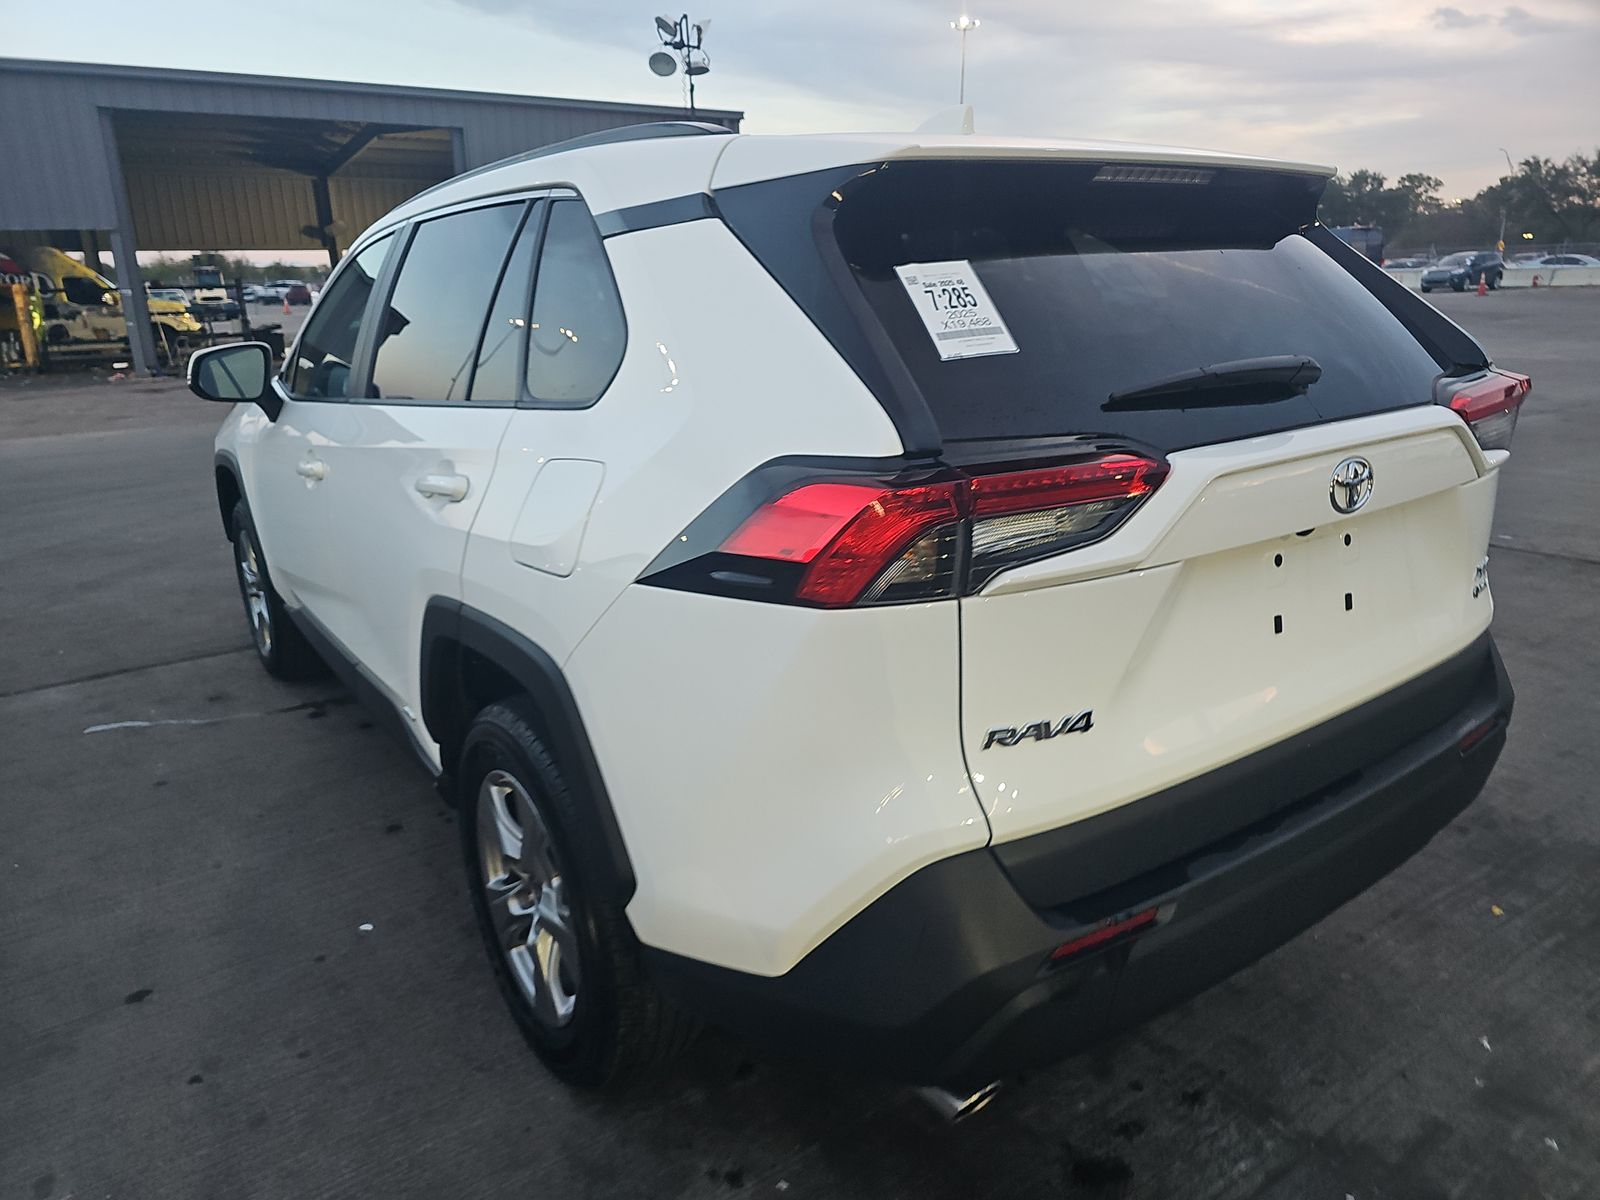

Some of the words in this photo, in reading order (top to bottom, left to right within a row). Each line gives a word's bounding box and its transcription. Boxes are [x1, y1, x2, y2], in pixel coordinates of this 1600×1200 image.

[924, 286, 978, 311] 7:285
[945, 308, 978, 320] 2025
[982, 708, 1095, 751] RAV4
